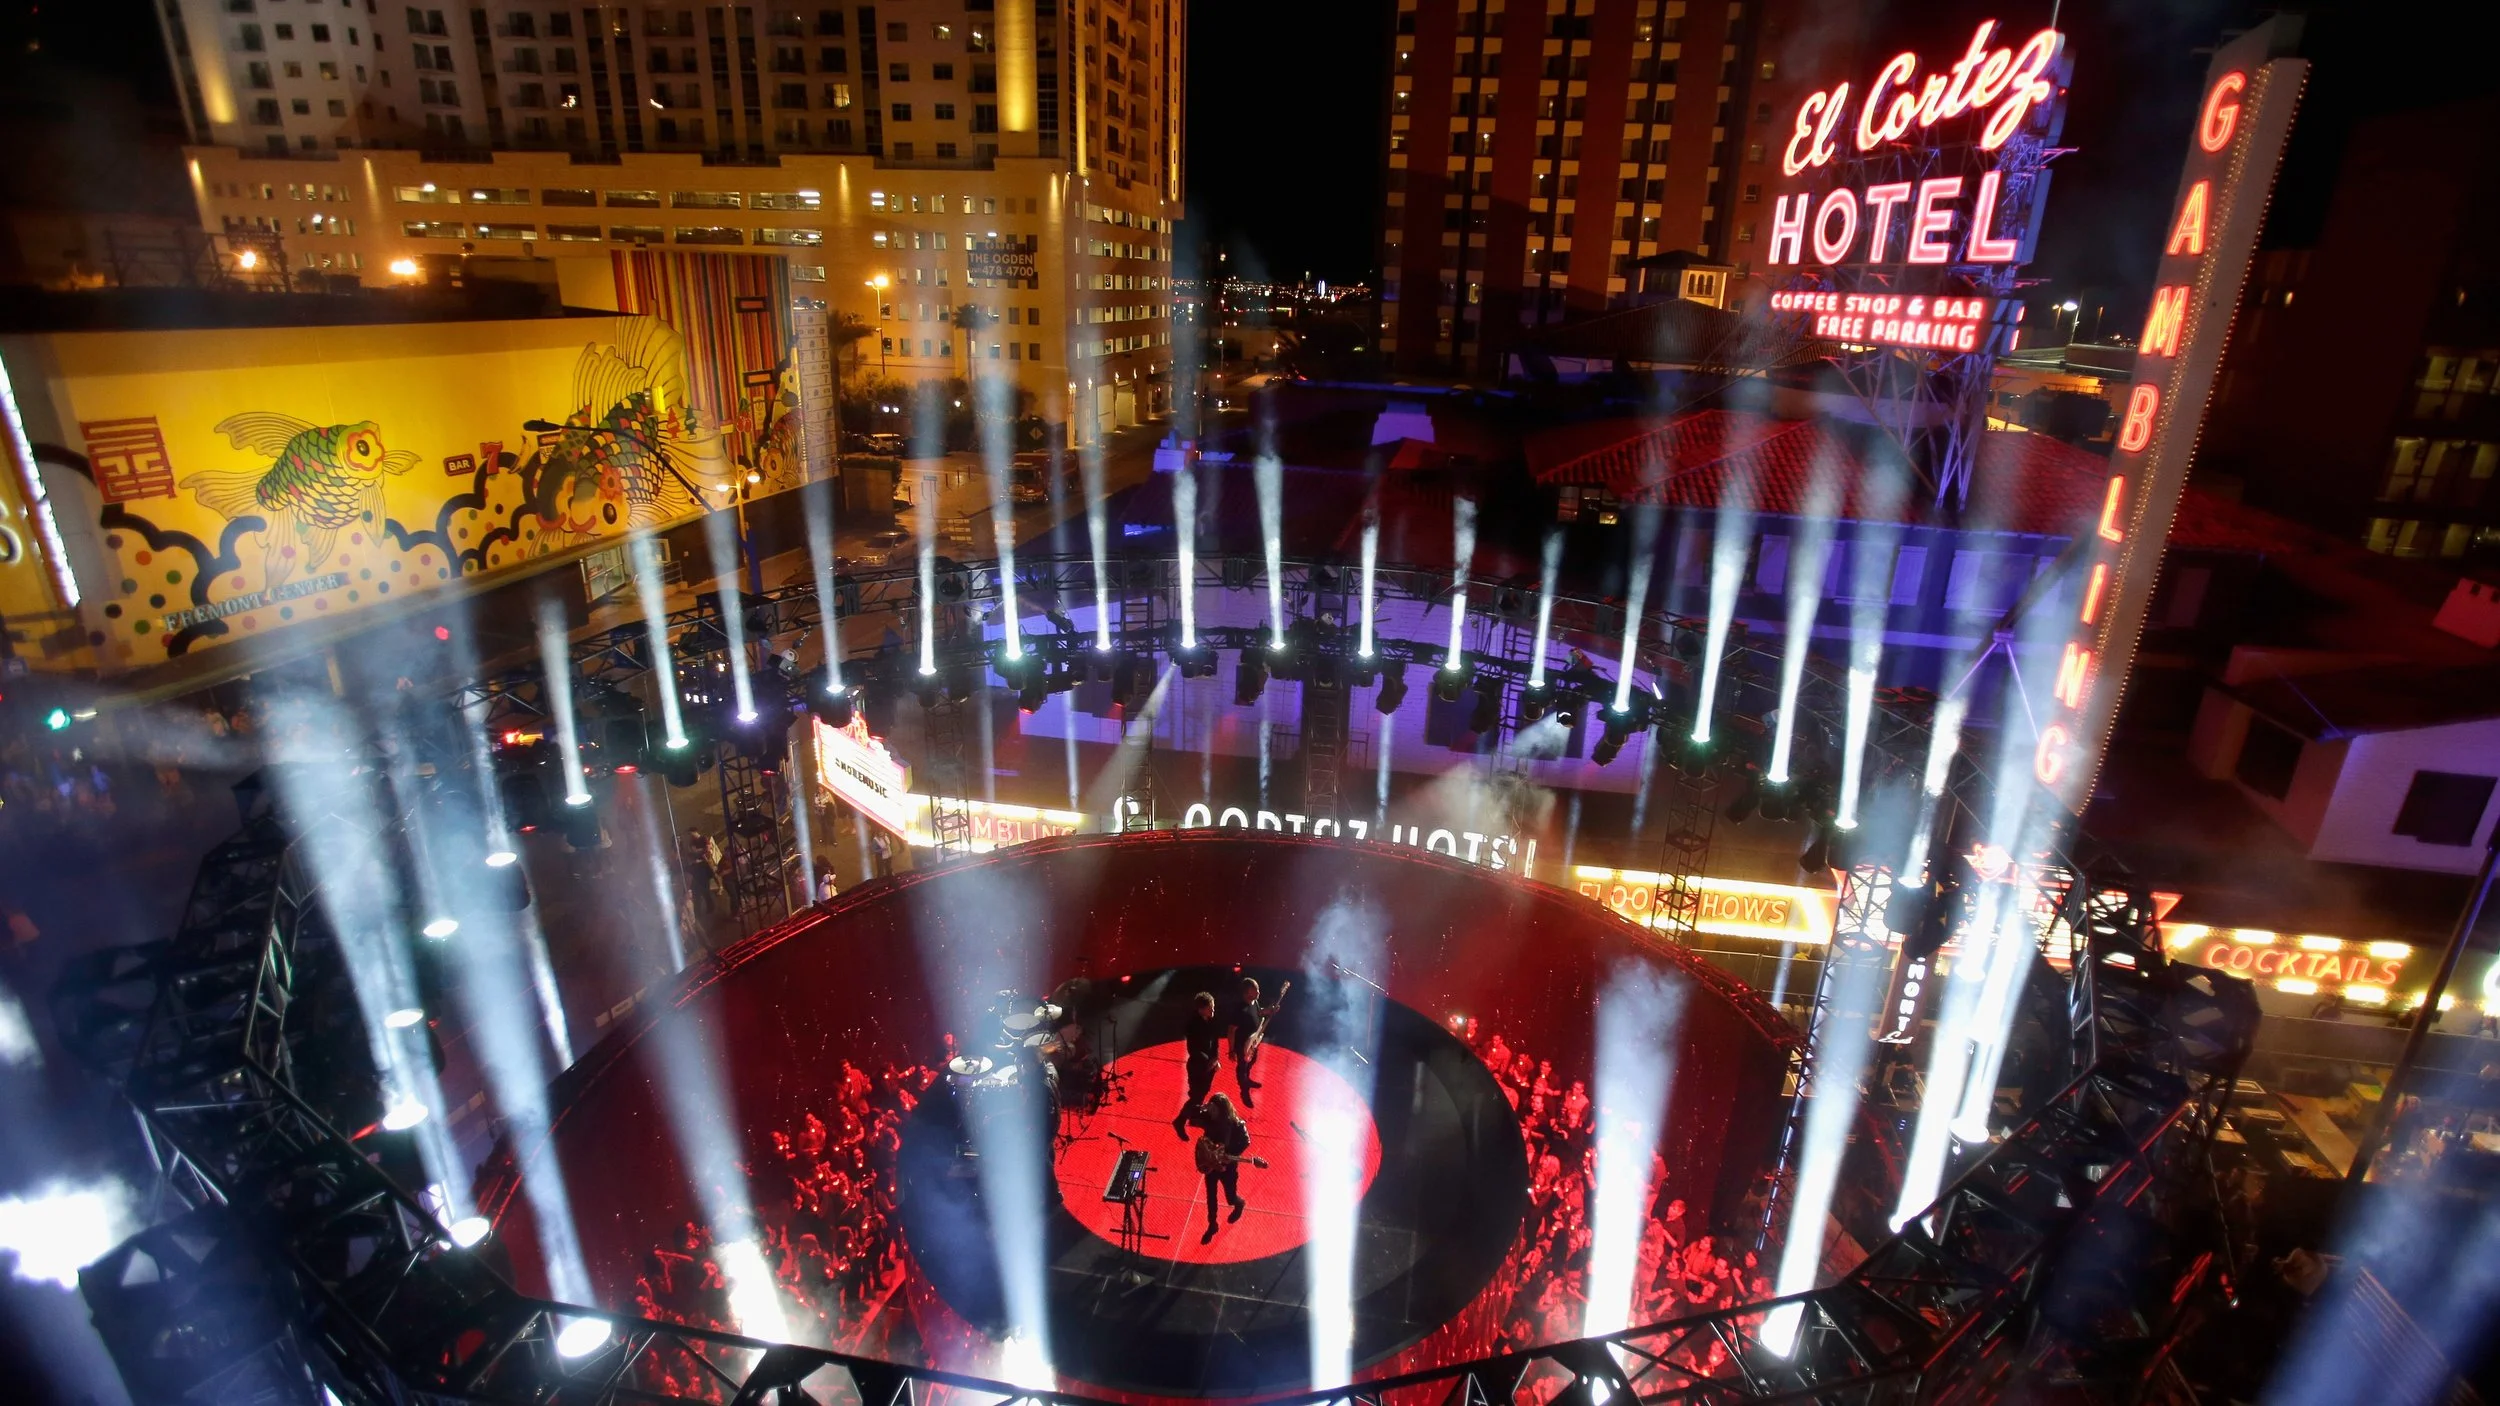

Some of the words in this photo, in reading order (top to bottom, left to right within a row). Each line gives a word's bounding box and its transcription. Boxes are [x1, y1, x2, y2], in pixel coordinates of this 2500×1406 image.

[1784, 82, 1849, 176] El
[1857, 19, 2057, 151] Cortez
[1769, 170, 2017, 265] HOTEL
[969, 253, 989, 264] THE
[992, 253, 1033, 264] OGDEN
[982, 265, 1003, 276] 478
[1006, 266, 1034, 277] 4700
[1771, 291, 1838, 311] COFFEE
[1845, 296, 1900, 315] SHOP
[1907, 298, 1924, 316] &
[1933, 299, 1983, 319] BAR
[1816, 315, 1865, 338] FREE
[1871, 319, 1977, 350] PARKING
[2033, 71, 2247, 786] GAMBLING
[448, 459, 471, 471] BAR
[480, 441, 503, 475] 7
[165, 591, 264, 631] FREMONT
[268, 574, 339, 603] CENTER
[2205, 943, 2403, 986] COCKTAILS
